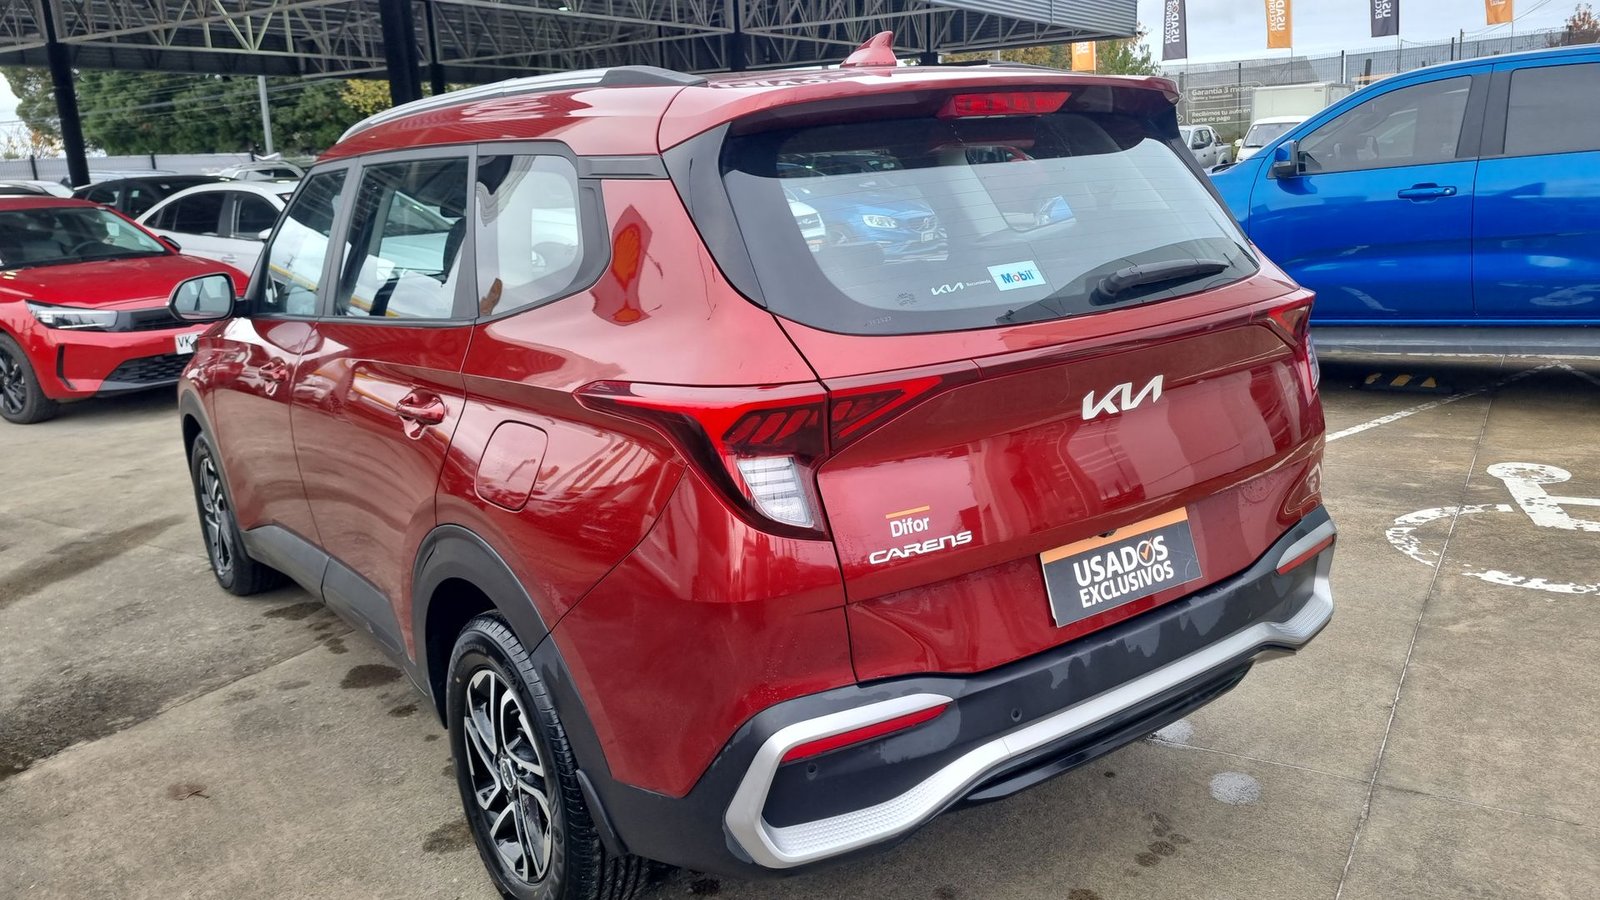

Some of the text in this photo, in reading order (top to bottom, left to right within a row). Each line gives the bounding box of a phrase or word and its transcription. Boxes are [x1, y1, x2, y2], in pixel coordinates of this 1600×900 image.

[1223, 86, 1229, 94] 3
[1000, 269, 1034, 284] Mobil
[1082, 374, 1164, 420] KIA
[889, 516, 930, 538] Difor
[868, 530, 973, 565] CARENS
[1072, 535, 1169, 587] USADOS
[1079, 560, 1174, 609] EXCLUSIVOS
